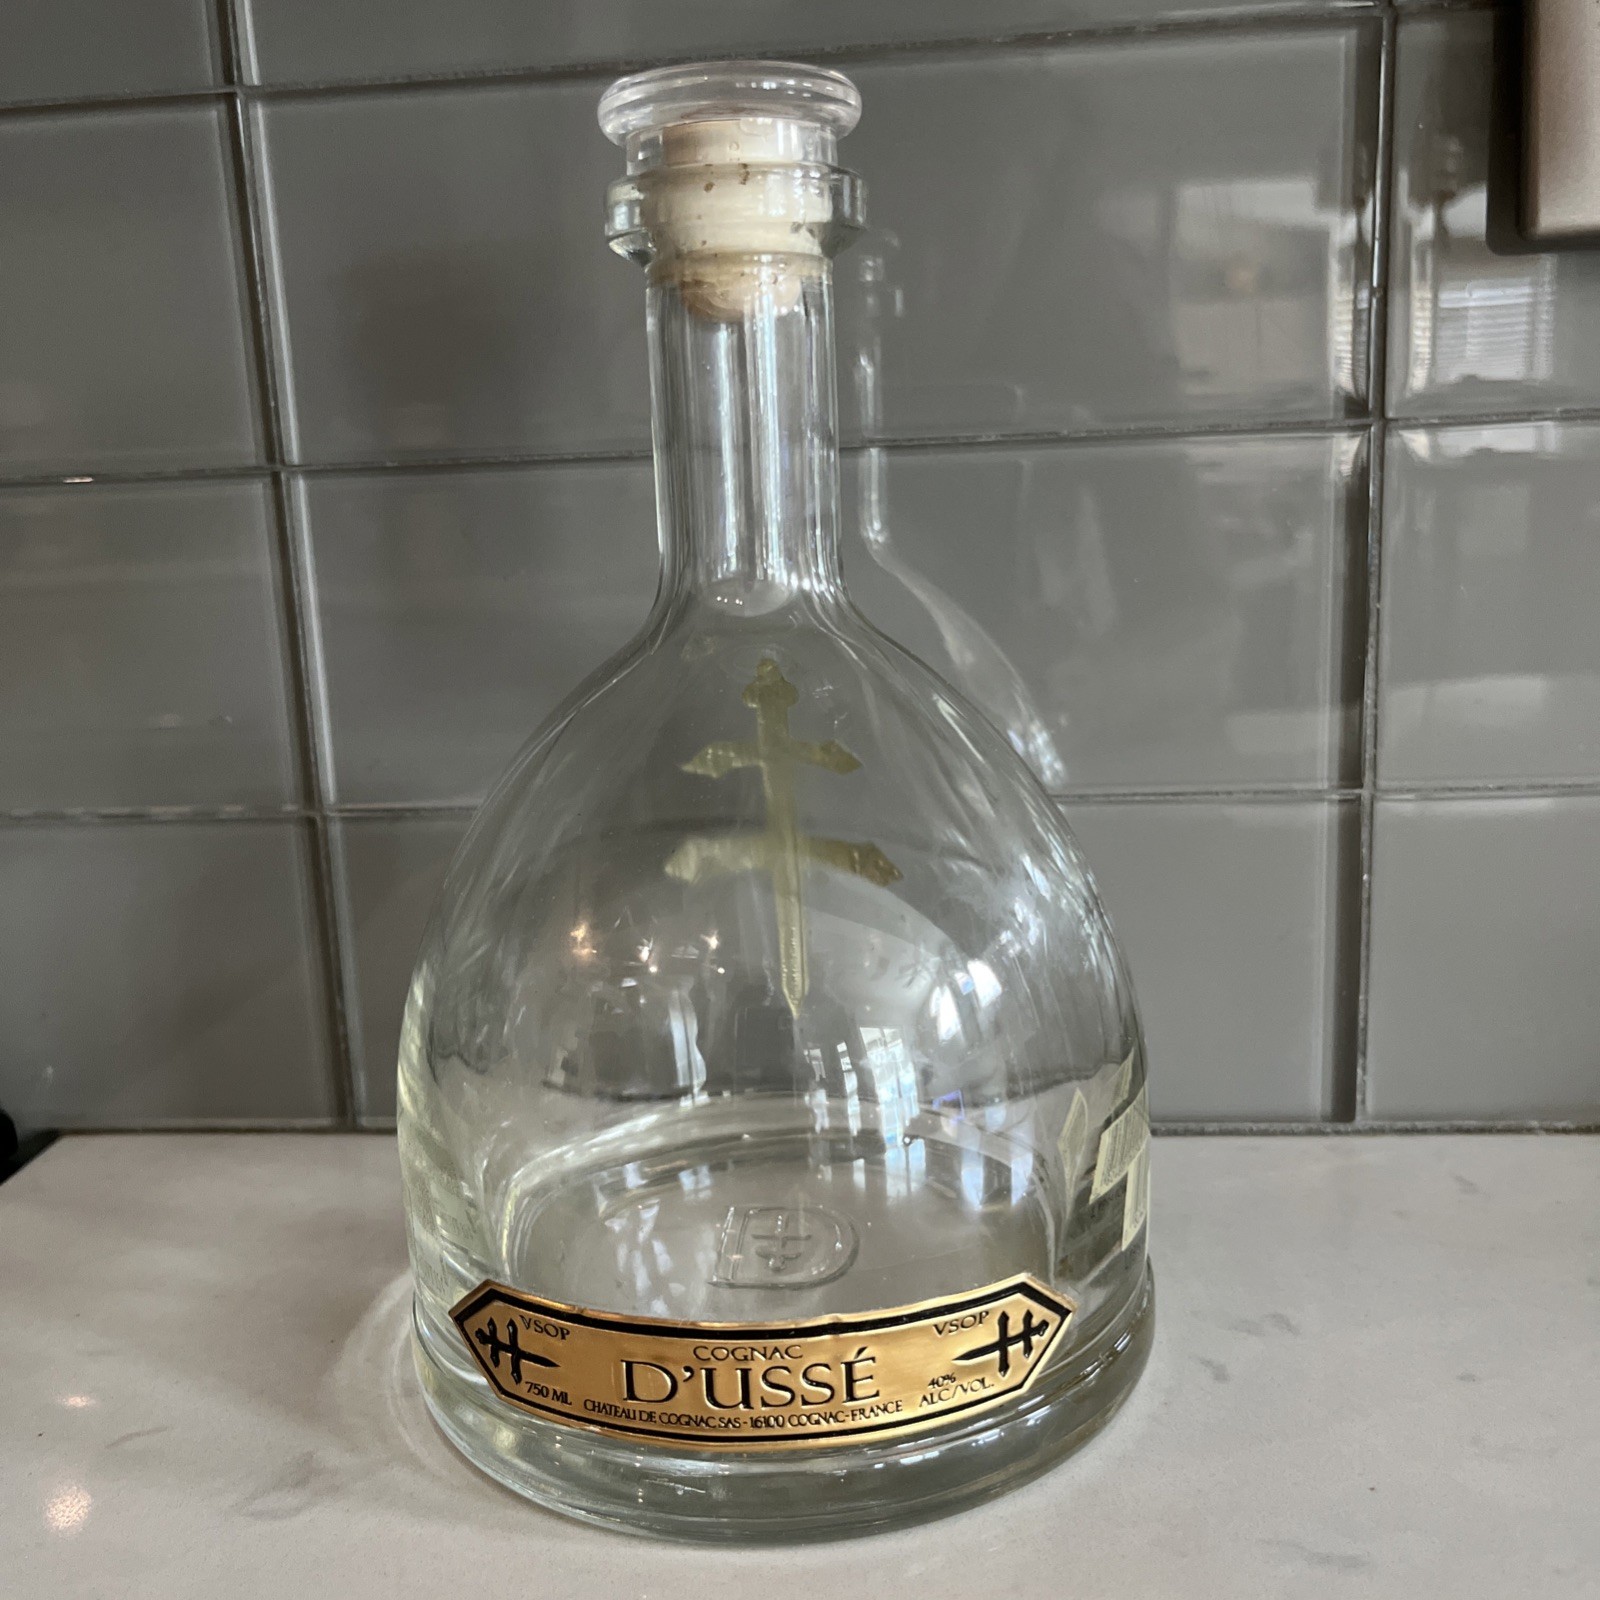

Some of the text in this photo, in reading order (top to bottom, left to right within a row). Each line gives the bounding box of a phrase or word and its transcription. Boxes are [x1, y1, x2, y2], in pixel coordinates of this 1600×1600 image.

[520, 1314, 571, 1341] VSOP
[933, 1310, 990, 1337] VSOP
[693, 1344, 804, 1362] COGNAC
[621, 1346, 881, 1411] D'USSÉ
[928, 1373, 957, 1390] 40%
[525, 1381, 573, 1406] 750 ML
[583, 1399, 638, 1421] CHATEAU
[639, 1409, 657, 1423] DE
[659, 1412, 718, 1429] COGNAC
[718, 1416, 741, 1430] SAS
